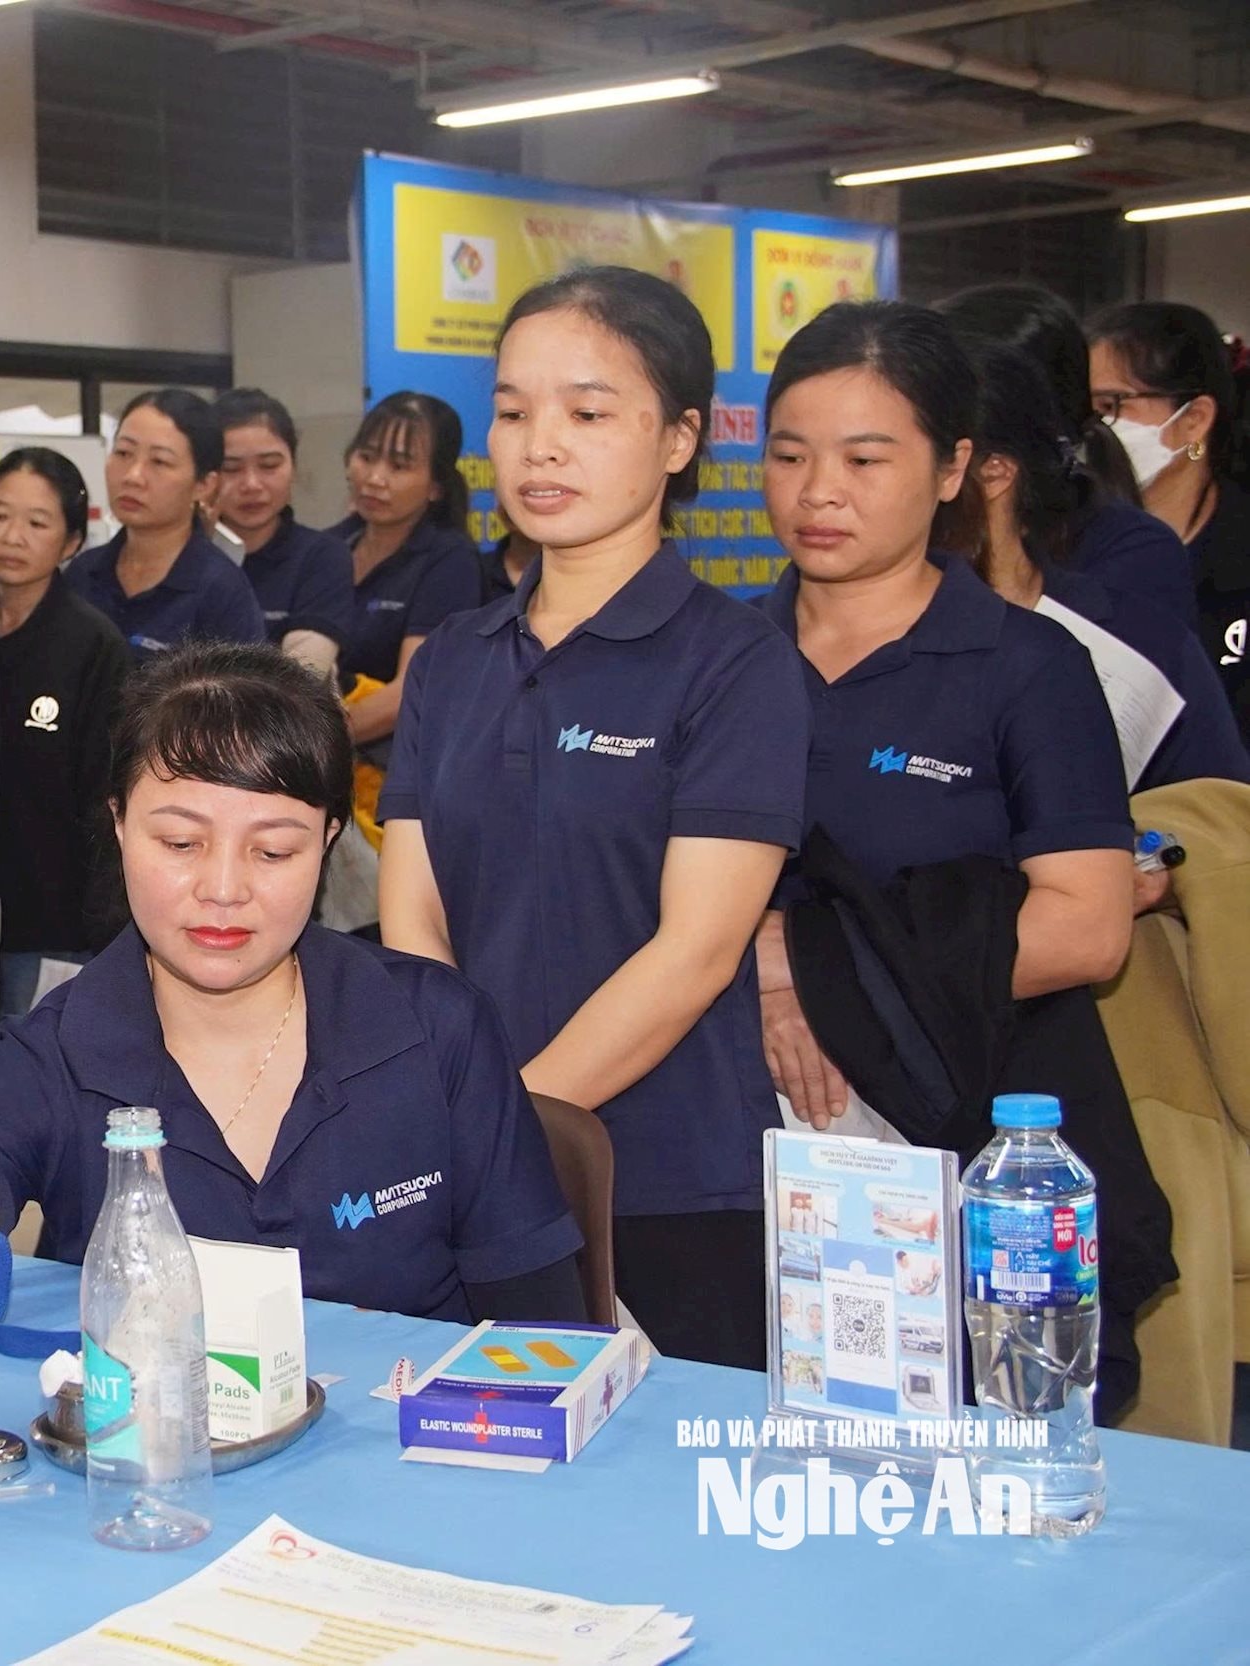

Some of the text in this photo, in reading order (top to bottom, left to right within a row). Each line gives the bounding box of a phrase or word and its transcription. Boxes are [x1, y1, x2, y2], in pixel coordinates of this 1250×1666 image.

[711, 398, 758, 444] ÌNH
[589, 742, 637, 757] CORPORATION
[593, 733, 655, 749] MATSUOKA
[905, 765, 952, 783] CORPORATION
[908, 755, 972, 777] MATSUOKA
[375, 1171, 443, 1204] MATSUOKA
[376, 1190, 427, 1215] CORPORATION
[83, 1370, 123, 1402] ANT
[214, 1382, 250, 1400] Pads
[420, 1419, 543, 1440] ELASTIC WOUNDPLASTER STERILE
